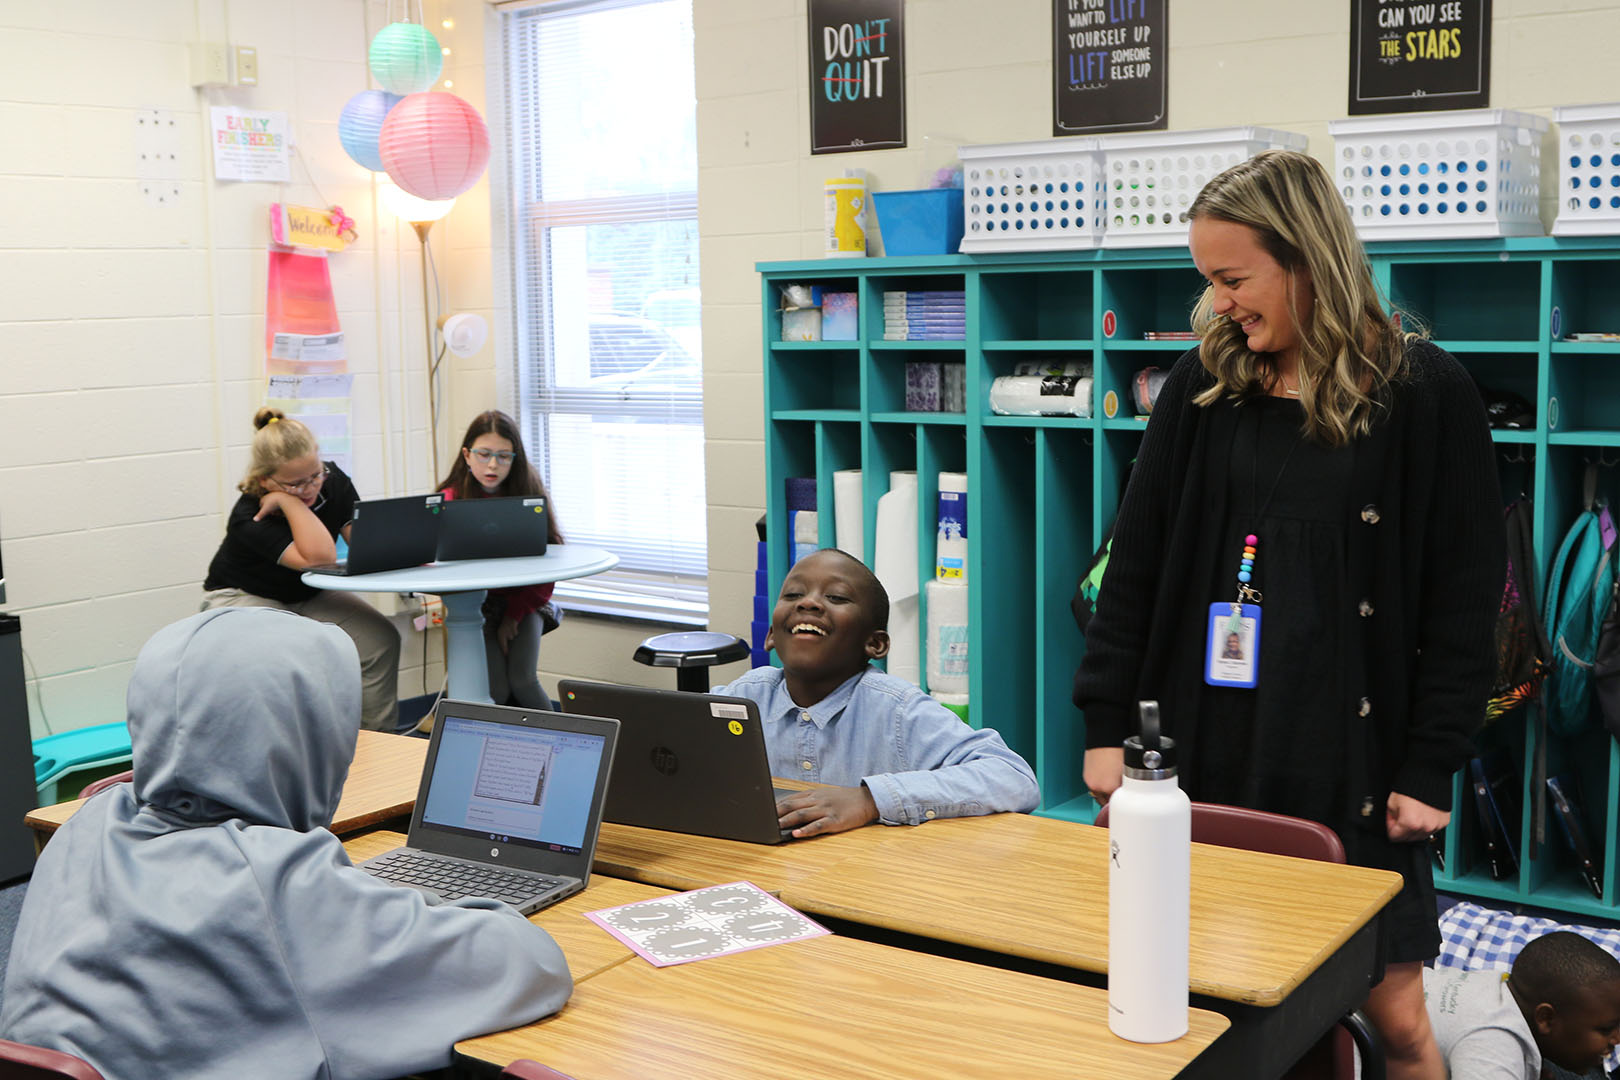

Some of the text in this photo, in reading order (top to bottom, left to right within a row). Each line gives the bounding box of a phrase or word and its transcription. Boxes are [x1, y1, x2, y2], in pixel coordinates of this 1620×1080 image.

[1068, 10, 1106, 28] WANT TO
[1378, 2, 1462, 28] CAN YOU SEE
[823, 18, 893, 61] DON'T
[1068, 25, 1151, 49] YOURSELF UP
[1380, 27, 1462, 62] THE STARS
[1111, 46, 1151, 63] SOMEONE
[1069, 51, 1108, 85] LIFT
[1110, 62, 1151, 80] ELSE UP
[823, 56, 890, 102] QUIT
[225, 115, 270, 132] EARLY
[217, 129, 283, 147] FINISHERS
[287, 212, 340, 238] Welcom
[711, 896, 749, 908] 3
[632, 912, 670, 925] 2
